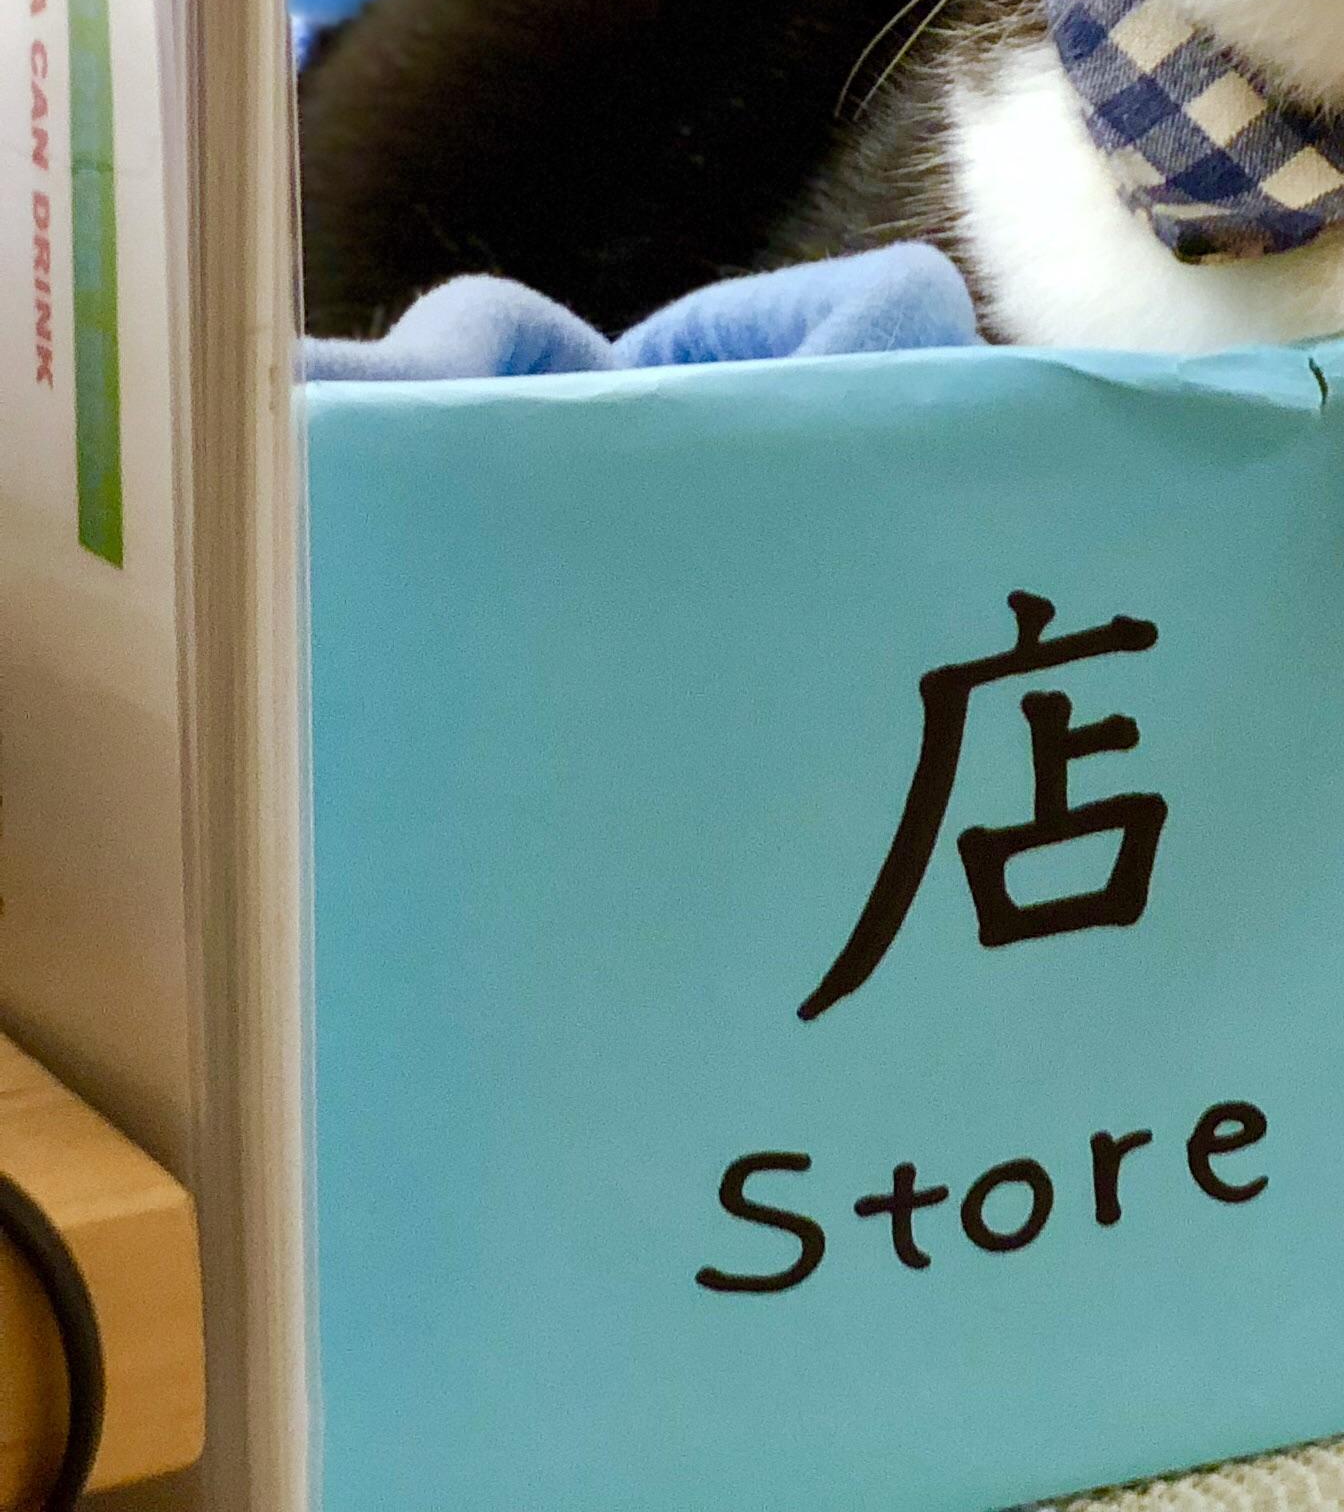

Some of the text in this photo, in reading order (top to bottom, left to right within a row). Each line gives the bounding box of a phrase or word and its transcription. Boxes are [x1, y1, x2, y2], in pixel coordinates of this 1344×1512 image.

[31, 39, 50, 172] CAN
[32, 190, 54, 388] DRINK
[694, 1100, 1270, 1296] Store
